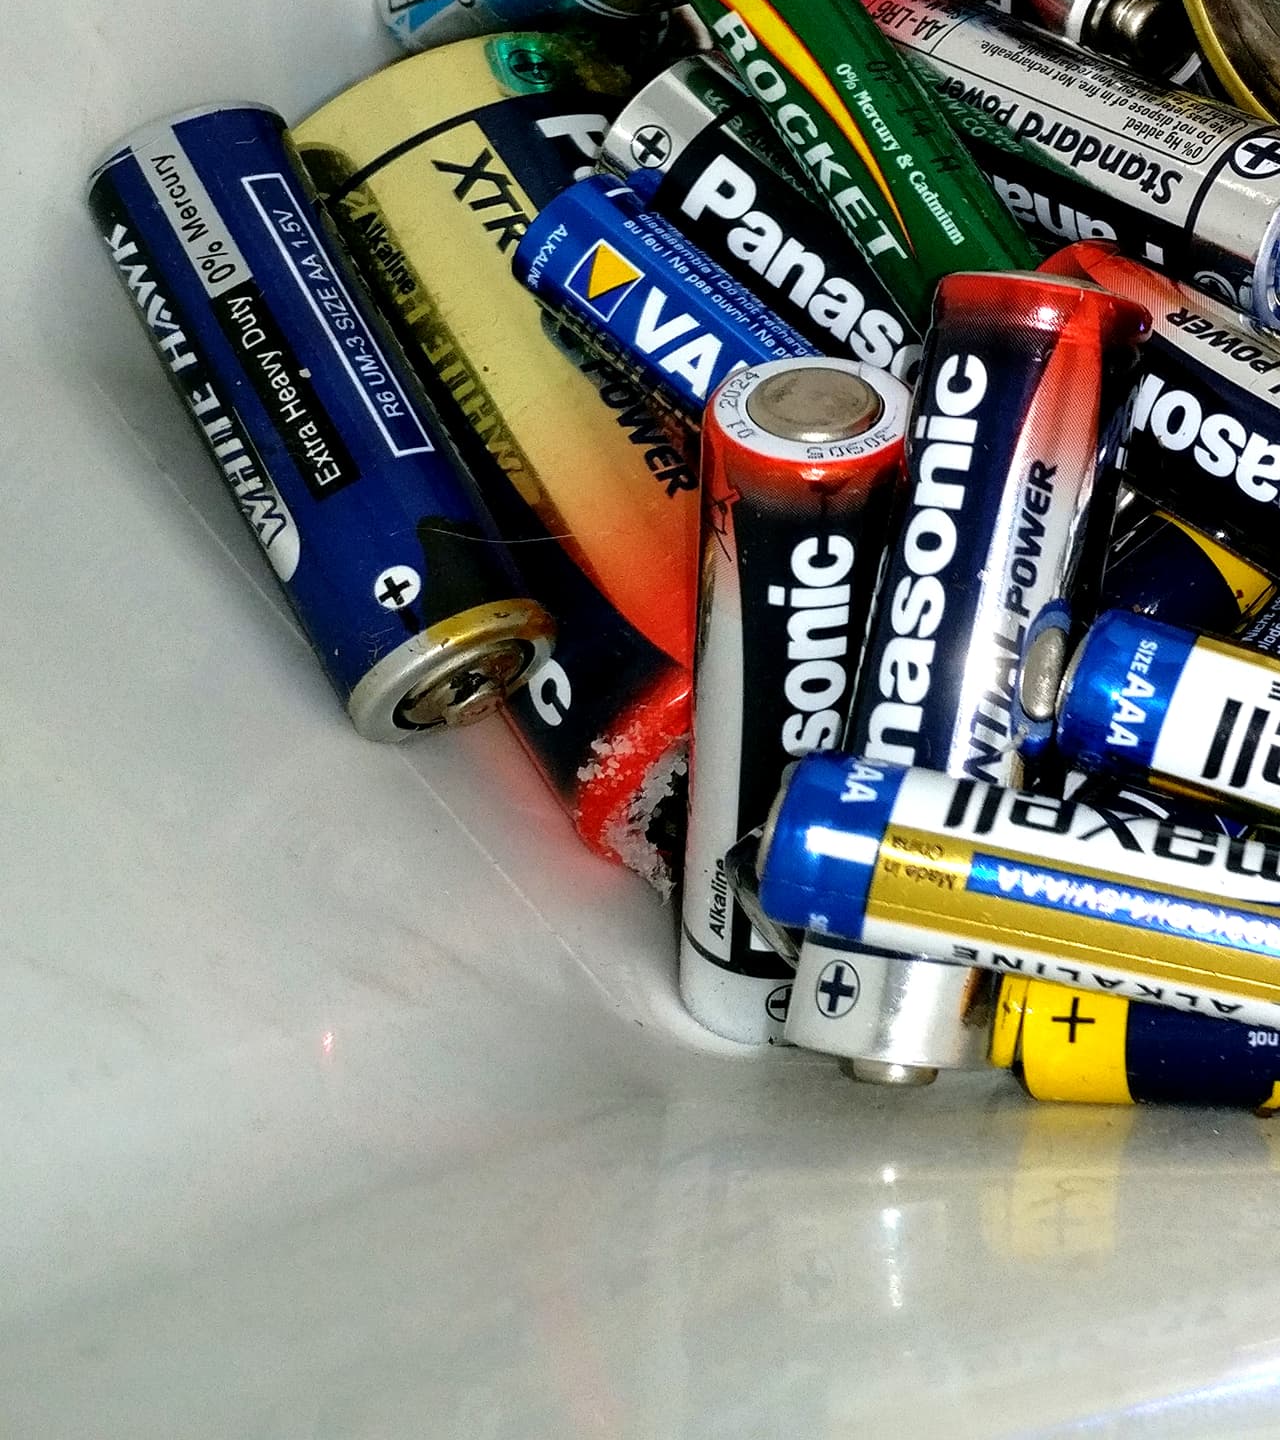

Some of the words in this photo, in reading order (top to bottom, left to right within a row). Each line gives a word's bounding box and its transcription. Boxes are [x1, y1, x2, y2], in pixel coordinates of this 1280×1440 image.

[711, 11, 909, 262] ROCKET
[1014, 98, 1184, 205] Standard
[1128, 97, 1180, 133] dispose
[147, 152, 209, 245] Mercury
[851, 80, 901, 157] Mercury
[906, 170, 967, 246] Cadmium
[198, 239, 237, 287] 0%
[273, 208, 313, 262] 1.5V
[225, 293, 270, 351] Duty
[322, 291, 360, 336] SIZE
[257, 345, 308, 426] Heavy
[342, 334, 389, 391] UM-3
[380, 386, 405, 420] R6
[295, 416, 343, 489] Extra
[864, 353, 988, 764] nasonic
[766, 533, 854, 756] sonic
[1104, 672, 1158, 748] AAA
[709, 857, 728, 940] Alkaline
[951, 944, 1244, 1015] ALKALINE
